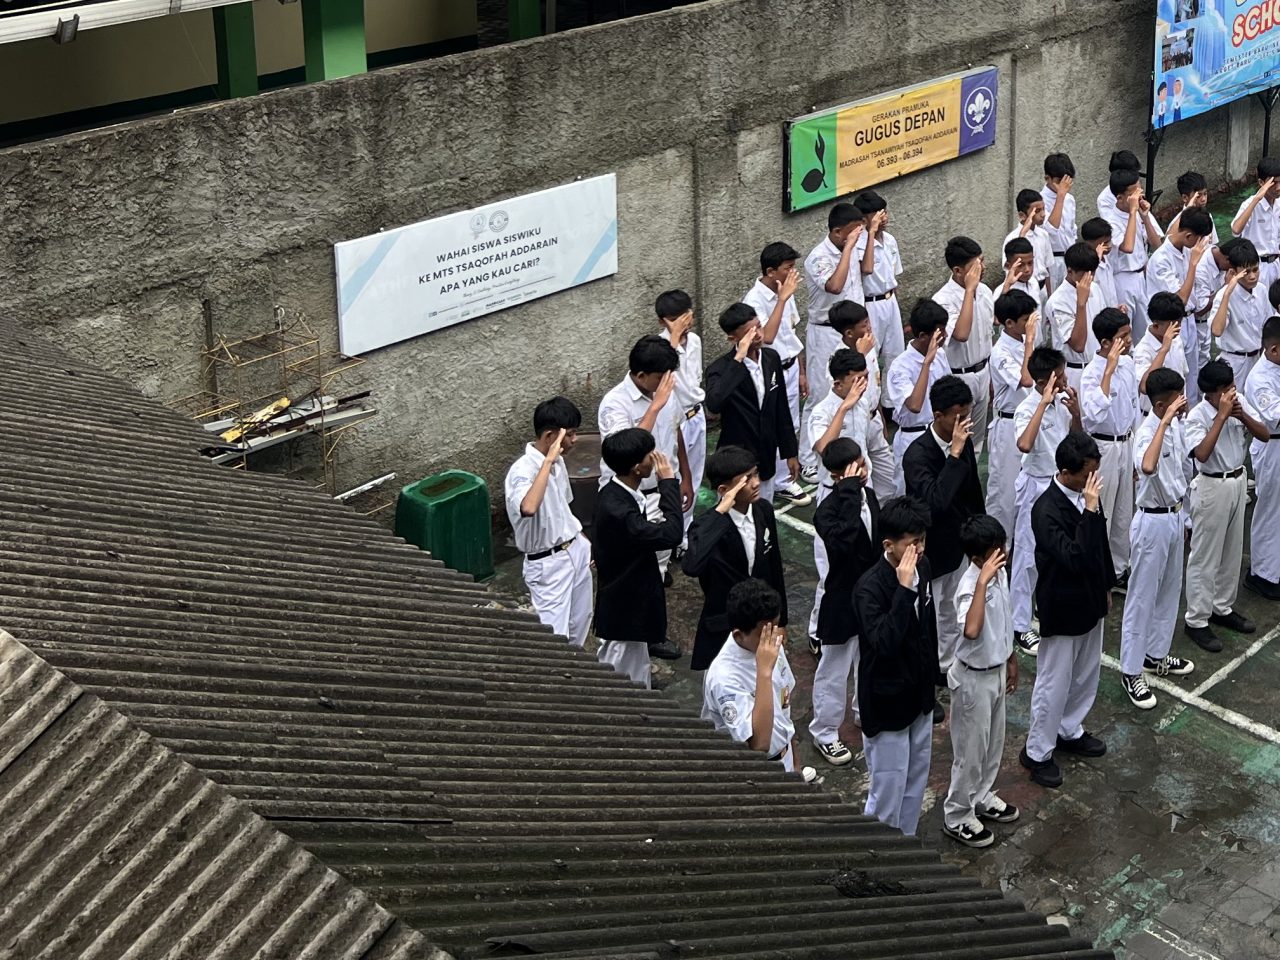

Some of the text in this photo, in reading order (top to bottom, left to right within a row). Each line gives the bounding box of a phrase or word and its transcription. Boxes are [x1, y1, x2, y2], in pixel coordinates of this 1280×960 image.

[854, 107, 945, 146] GUGUS DEPAN
[872, 100, 930, 123] GERAKAN PRAMUKA
[839, 153, 870, 169] MADRASAH
[932, 127, 958, 139] ADDARAIN
[418, 237, 558, 285] KE MTS TSAQOFAH ADDARAIN
[436, 227, 542, 263] WAHAI SISWA SISWIKU
[440, 282, 461, 295] APA
[462, 273, 490, 288] YANG
[491, 266, 512, 278] KAU
[513, 257, 541, 272] CARI?
